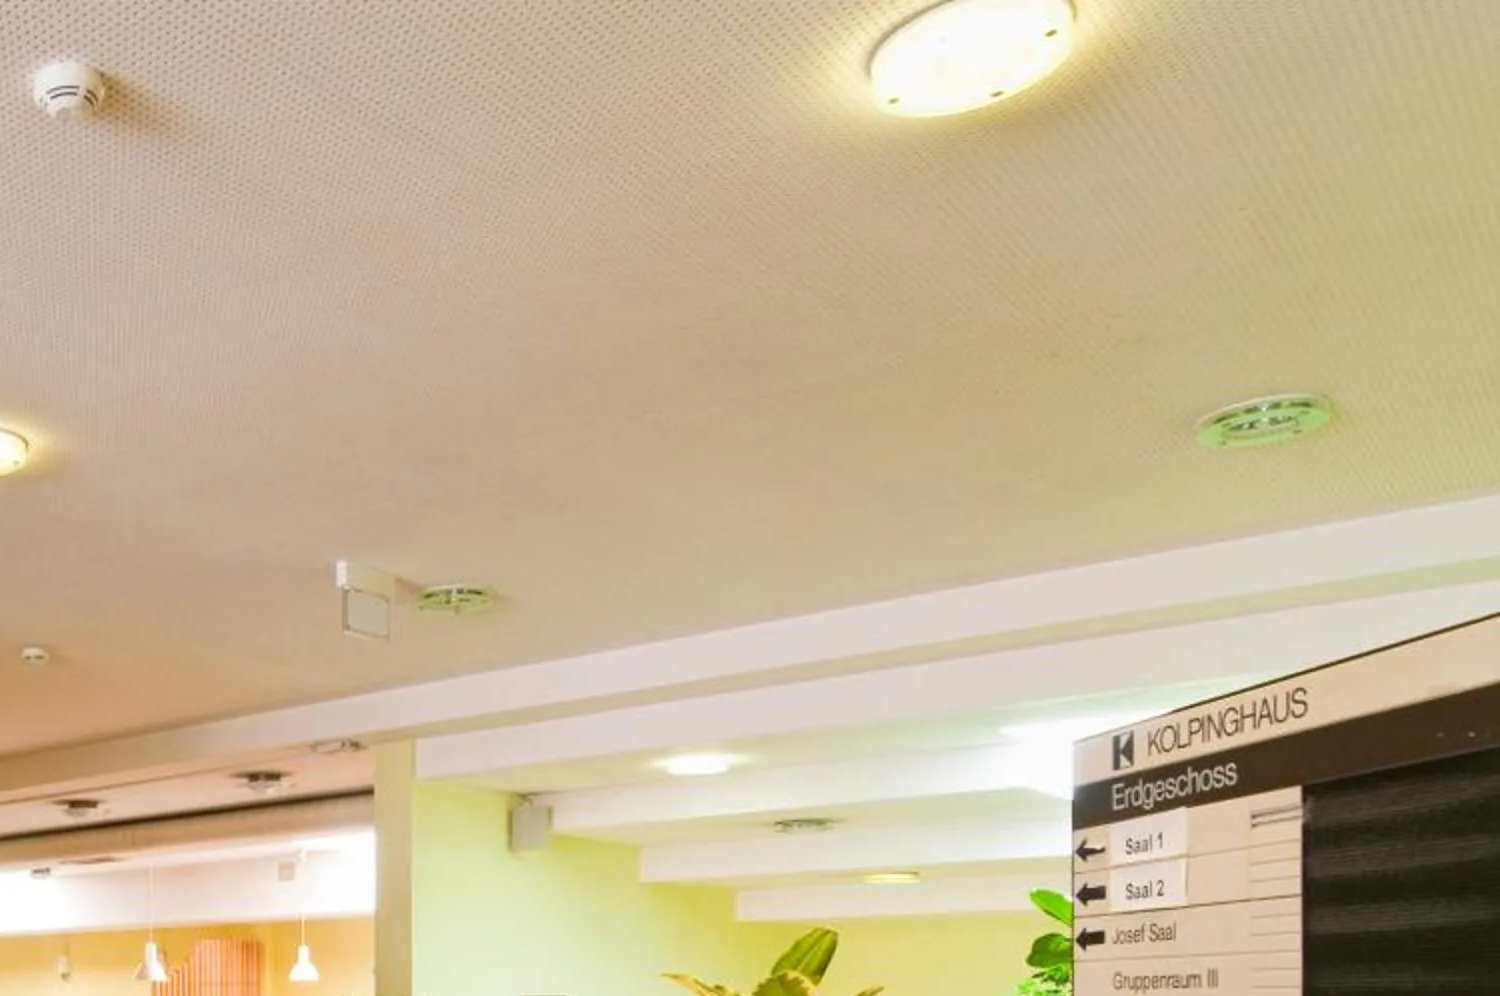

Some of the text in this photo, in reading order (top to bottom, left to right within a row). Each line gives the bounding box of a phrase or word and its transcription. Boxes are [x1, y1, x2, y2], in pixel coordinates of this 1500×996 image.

[1146, 687, 1309, 757] KOLPINGHAUS
[1111, 761, 1238, 812] Erdgeschoss
[1125, 834, 1164, 855] Saal 1
[1125, 879, 1166, 900] Saal 2
[1111, 920, 1177, 945] Josef Saal
[1112, 968, 1219, 993] Gruppenraum III
